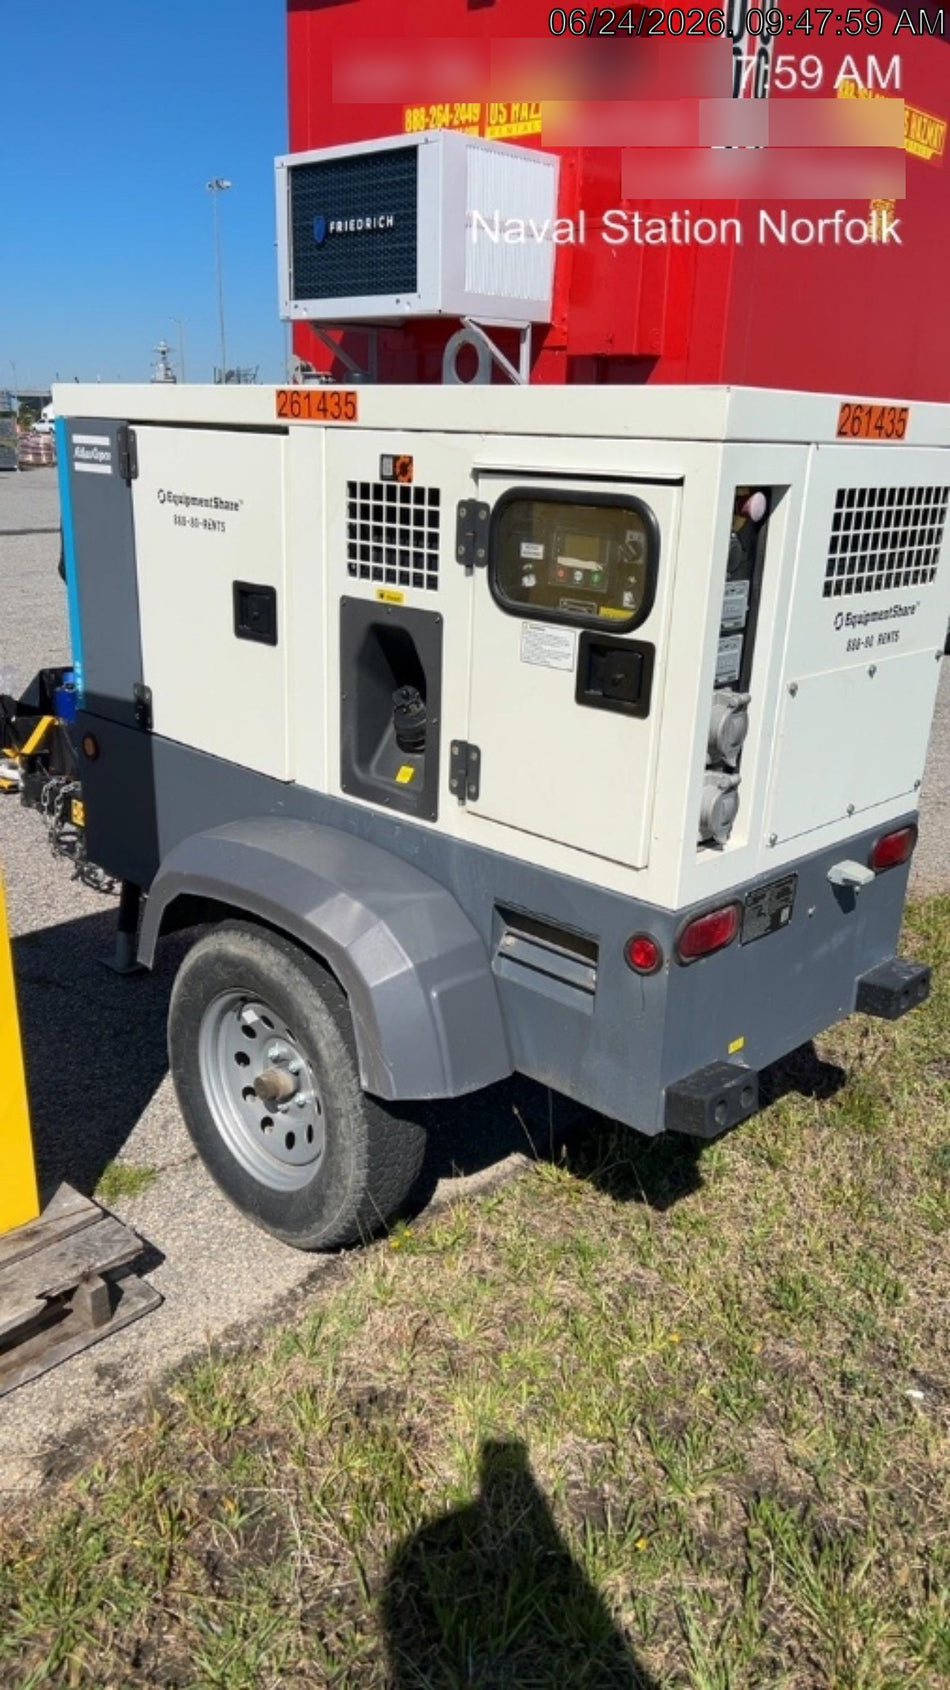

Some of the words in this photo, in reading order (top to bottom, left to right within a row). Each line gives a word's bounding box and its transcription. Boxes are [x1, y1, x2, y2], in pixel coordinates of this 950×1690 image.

[329, 215, 394, 234] FRIEDRICH
[277, 390, 356, 419] 261435
[837, 404, 909, 438] 261435
